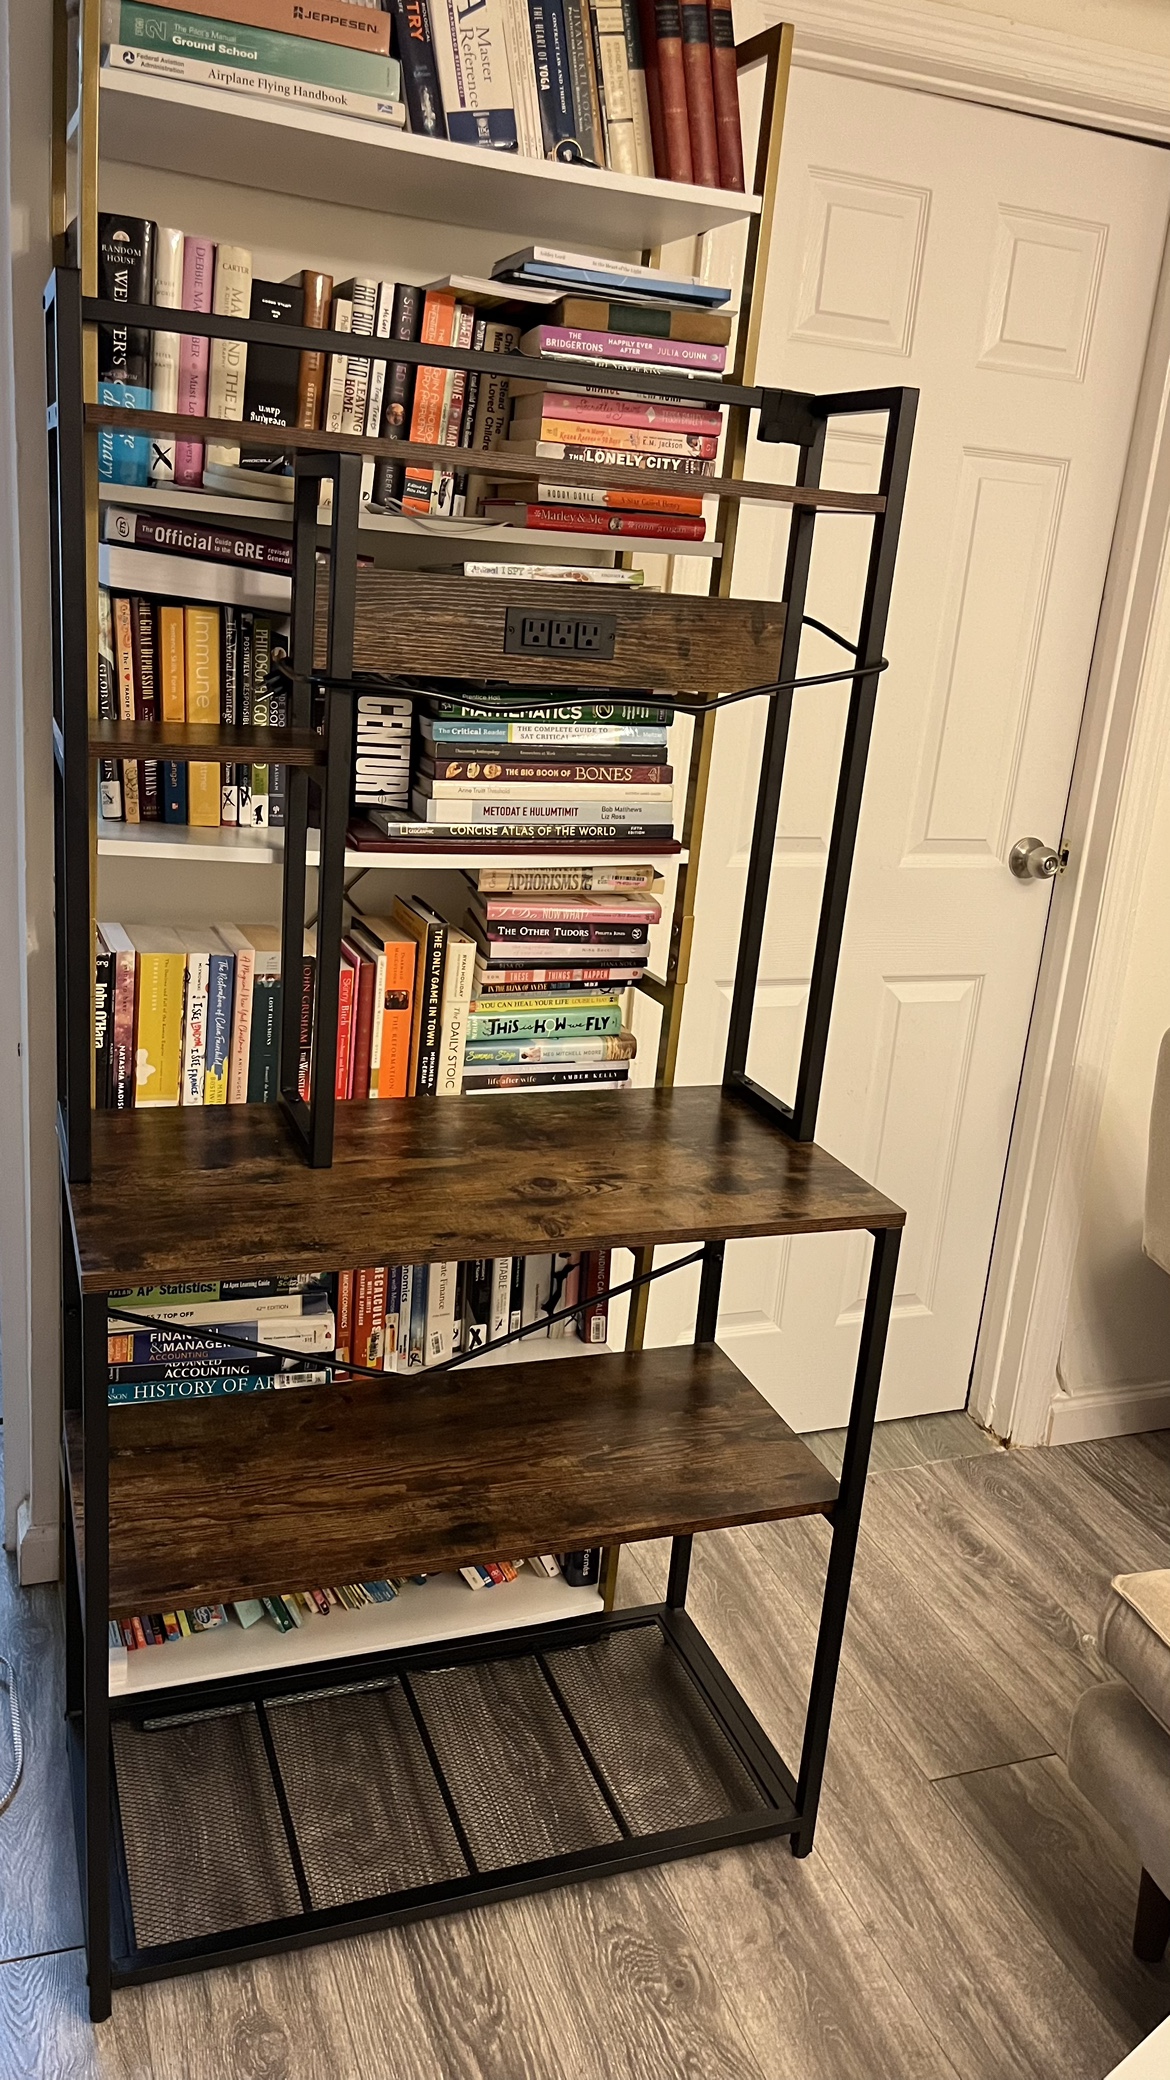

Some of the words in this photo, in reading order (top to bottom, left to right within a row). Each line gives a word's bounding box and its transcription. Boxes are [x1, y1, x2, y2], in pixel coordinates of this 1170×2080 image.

[304, 11, 378, 34] JEPPESEN
[533, 7, 543, 20] THE
[535, 24, 547, 50] HEART
[172, 36, 216, 52] Ground
[218, 44, 258, 60] School
[476, 26, 492, 83] Master
[538, 51, 548, 61] OF
[136, 52, 159, 62] Federal
[160, 57, 185, 67] Aviation
[141, 62, 185, 74] Administration
[460, 27, 479, 108] Reference
[552, 12, 561, 51] CONTRACT
[559, 85, 567, 114] THEORY
[539, 64, 550, 91] YOGA
[573, 8, 587, 86] JIVAMUKTI
[582, 93, 593, 132] YOGA
[208, 69, 255, 87] Airplane
[257, 78, 291, 96] Flying
[293, 85, 348, 106] Handbook
[101, 244, 142, 257] RANDOM
[106, 254, 136, 265] HOUSE
[222, 263, 250, 275] CARTER
[568, 331, 582, 340] THE
[608, 338, 635, 349] HAPPILY
[636, 342, 653, 350] EVER
[545, 337, 604, 353] BRIDGERTONS
[619, 347, 641, 356] AFTER
[657, 347, 679, 358] JULIA
[681, 350, 707, 361] QUINN
[343, 379, 356, 414] HOME
[371, 387, 383, 403] Tray
[498, 380, 510, 411] Stead
[258, 404, 281, 417] dawn
[353, 380, 367, 433] LEAVING
[250, 411, 287, 428] breaking
[371, 405, 380, 431] Treats
[495, 416, 505, 435] The
[657, 438, 683, 450] Jackson
[569, 453, 584, 462] THE
[585, 448, 645, 467] LONELY
[646, 456, 682, 471] CITY
[407, 482, 421, 490] Edited
[547, 489, 572, 500] RODDY
[573, 491, 595, 502] DOYLE
[540, 508, 577, 524] Marley
[576, 515, 587, 524] &
[587, 515, 604, 525] Me
[142, 524, 154, 534] The
[154, 526, 212, 551] Official
[214, 537, 232, 547] Guide
[234, 541, 264, 560] GRE
[267, 547, 290, 557] revised
[507, 566, 525, 576] SPY
[195, 615, 214, 709] Immune
[98, 663, 109, 714] GLOBAL
[438, 727, 450, 735] The
[451, 727, 481, 736] Critical
[483, 729, 507, 737] Reader
[355, 696, 413, 809] CENTURY
[505, 768, 519, 776] THE
[520, 768, 534, 776] BIG
[536, 769, 559, 777] BOOK
[560, 769, 571, 777] OF
[574, 766, 633, 781] BONES
[483, 806, 520, 816] METODAT
[522, 807, 528, 816] E
[529, 807, 579, 817] HULUMTIMIT
[450, 825, 498, 836] CONCISE
[500, 826, 535, 836] ATLAS
[537, 826, 552, 836] OF
[556, 826, 576, 836] THE
[578, 826, 617, 836] WORLD
[506, 873, 579, 891] APHORISMS
[433, 929, 444, 950] THE
[497, 926, 517, 936] THE
[519, 926, 550, 936] OTHER
[554, 927, 590, 937] TUDORS
[431, 951, 442, 979] ONLY
[239, 964, 250, 992] Magical
[302, 964, 312, 992] JOHN
[510, 972, 529, 981] THESE
[548, 971, 571, 980] THINGS
[583, 969, 608, 979] HAPPEN
[239, 994, 250, 1008] New
[429, 979, 440, 1005] GAME
[300, 995, 310, 1043] GRISHAM
[428, 1006, 438, 1017] IN
[453, 1007, 461, 1020] The
[425, 1018, 437, 1047] TOWN
[533, 1016, 567, 1034] HOW
[585, 1016, 611, 1031] FLY
[448, 1021, 461, 1053] DAILY
[445, 1055, 458, 1089] STOIC
[501, 1076, 519, 1084] after
[520, 1075, 537, 1083] wife
[137, 1285, 154, 1297] AP
[159, 1283, 217, 1296] Statistics:
[240, 1280, 258, 1289] Learning
[438, 1278, 448, 1310] Finance
[341, 1274, 349, 1329] MICROECONOMICS
[149, 1350, 209, 1361] ACCOUNTING
[164, 1365, 250, 1379] ACCOUNTING
[133, 1380, 218, 1399] HISTORY
[222, 1377, 248, 1393] OF
[582, 1548, 592, 1576] Fornés
